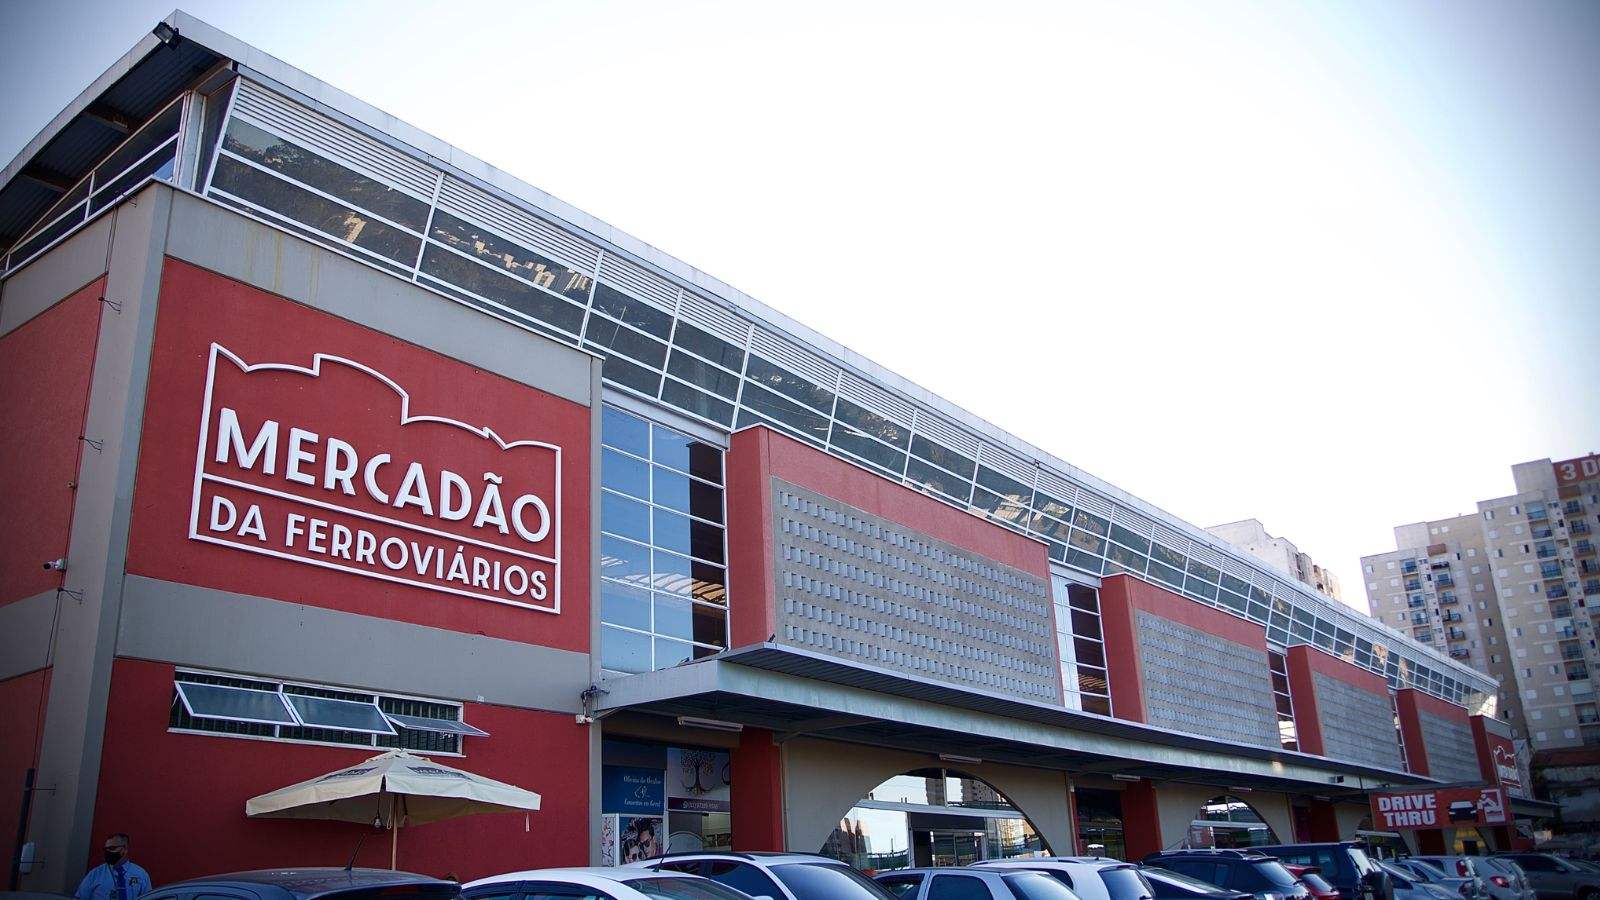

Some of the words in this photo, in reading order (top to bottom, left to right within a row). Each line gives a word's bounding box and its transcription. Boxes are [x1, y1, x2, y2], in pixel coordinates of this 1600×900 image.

[215, 407, 551, 543] MERCADÃO
[1560, 463, 1576, 481] 3
[210, 495, 267, 541] DA
[285, 512, 547, 601] FERROVIÁRIOS
[1377, 794, 1437, 811] DRIVE
[1383, 810, 1436, 827] THRU
